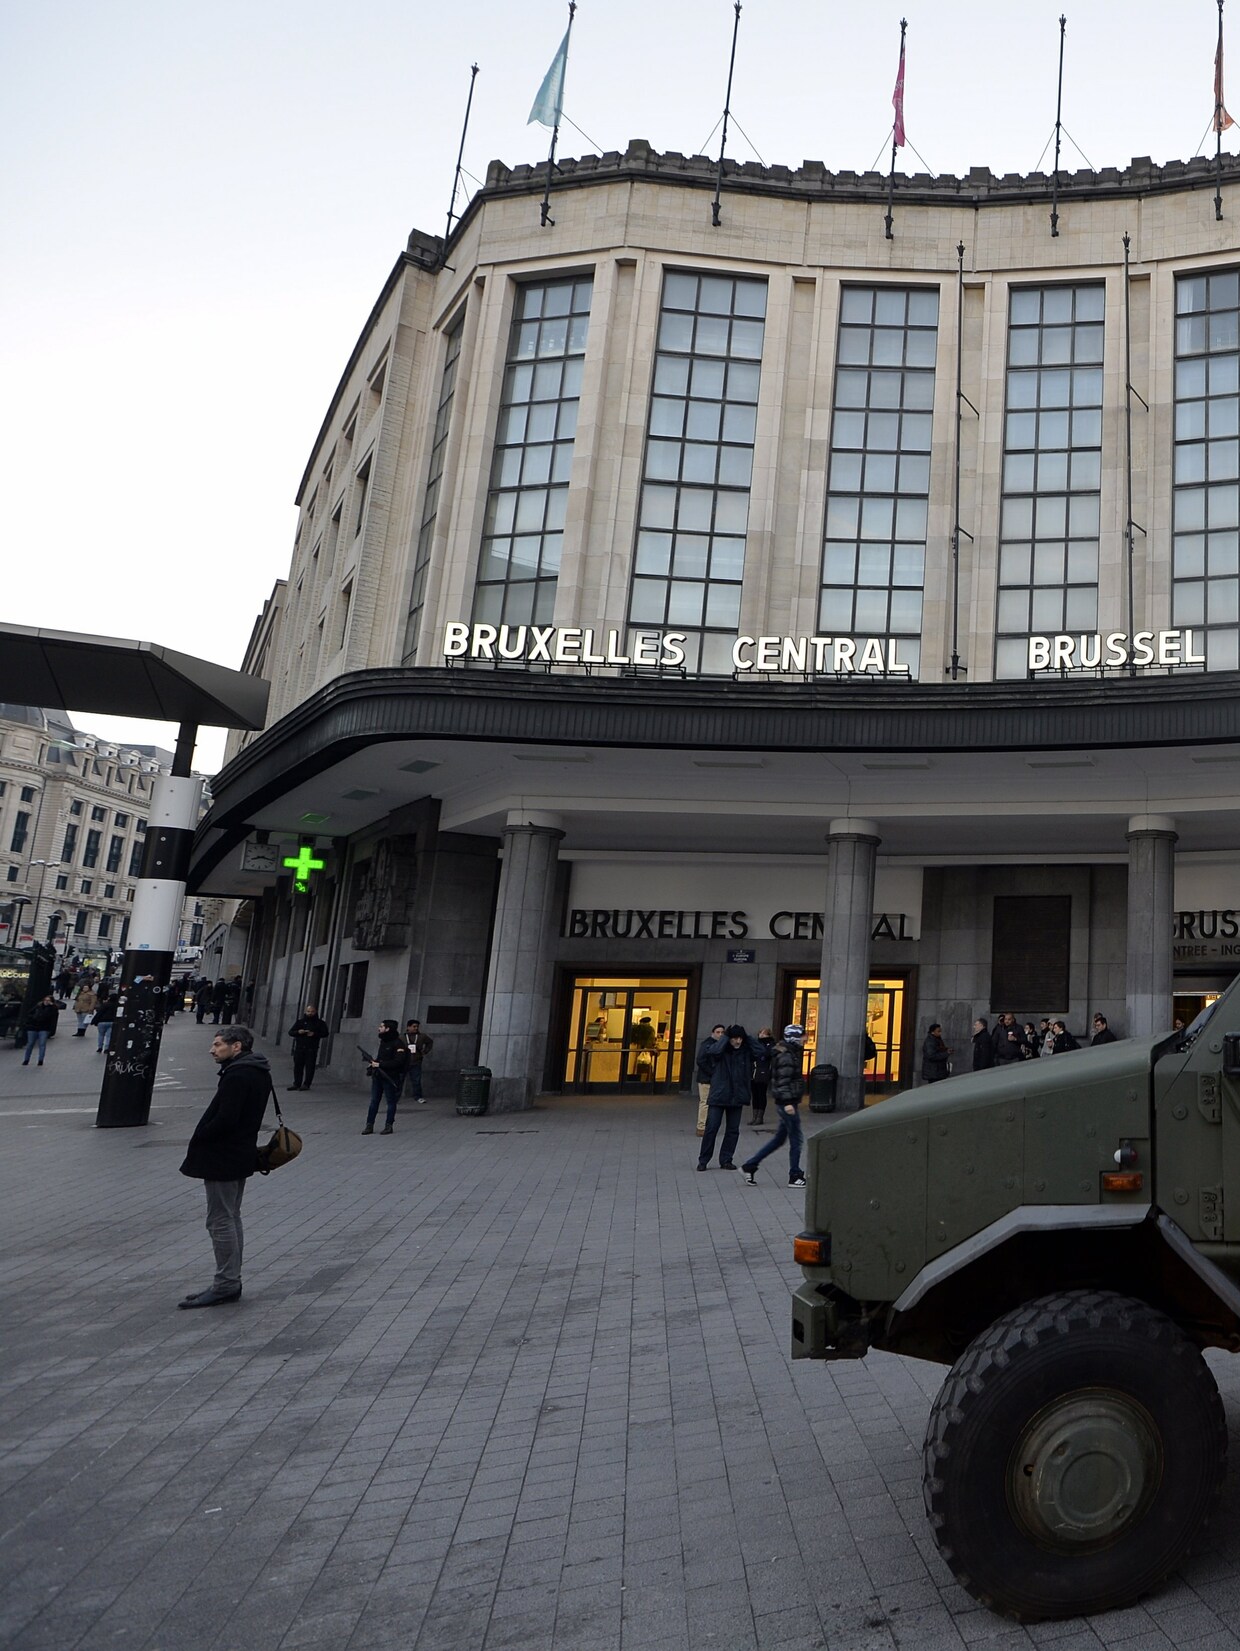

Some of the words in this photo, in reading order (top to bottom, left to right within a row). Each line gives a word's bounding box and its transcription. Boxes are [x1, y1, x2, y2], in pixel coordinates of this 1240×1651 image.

[443, 621, 687, 667] BRUXELLES
[731, 635, 910, 672] CENTRAL
[1027, 628, 1206, 670] BRUSSEL
[569, 909, 749, 939] BRUXELLES
[768, 910, 914, 942] CENAL
[1173, 945, 1208, 957] NTREE
